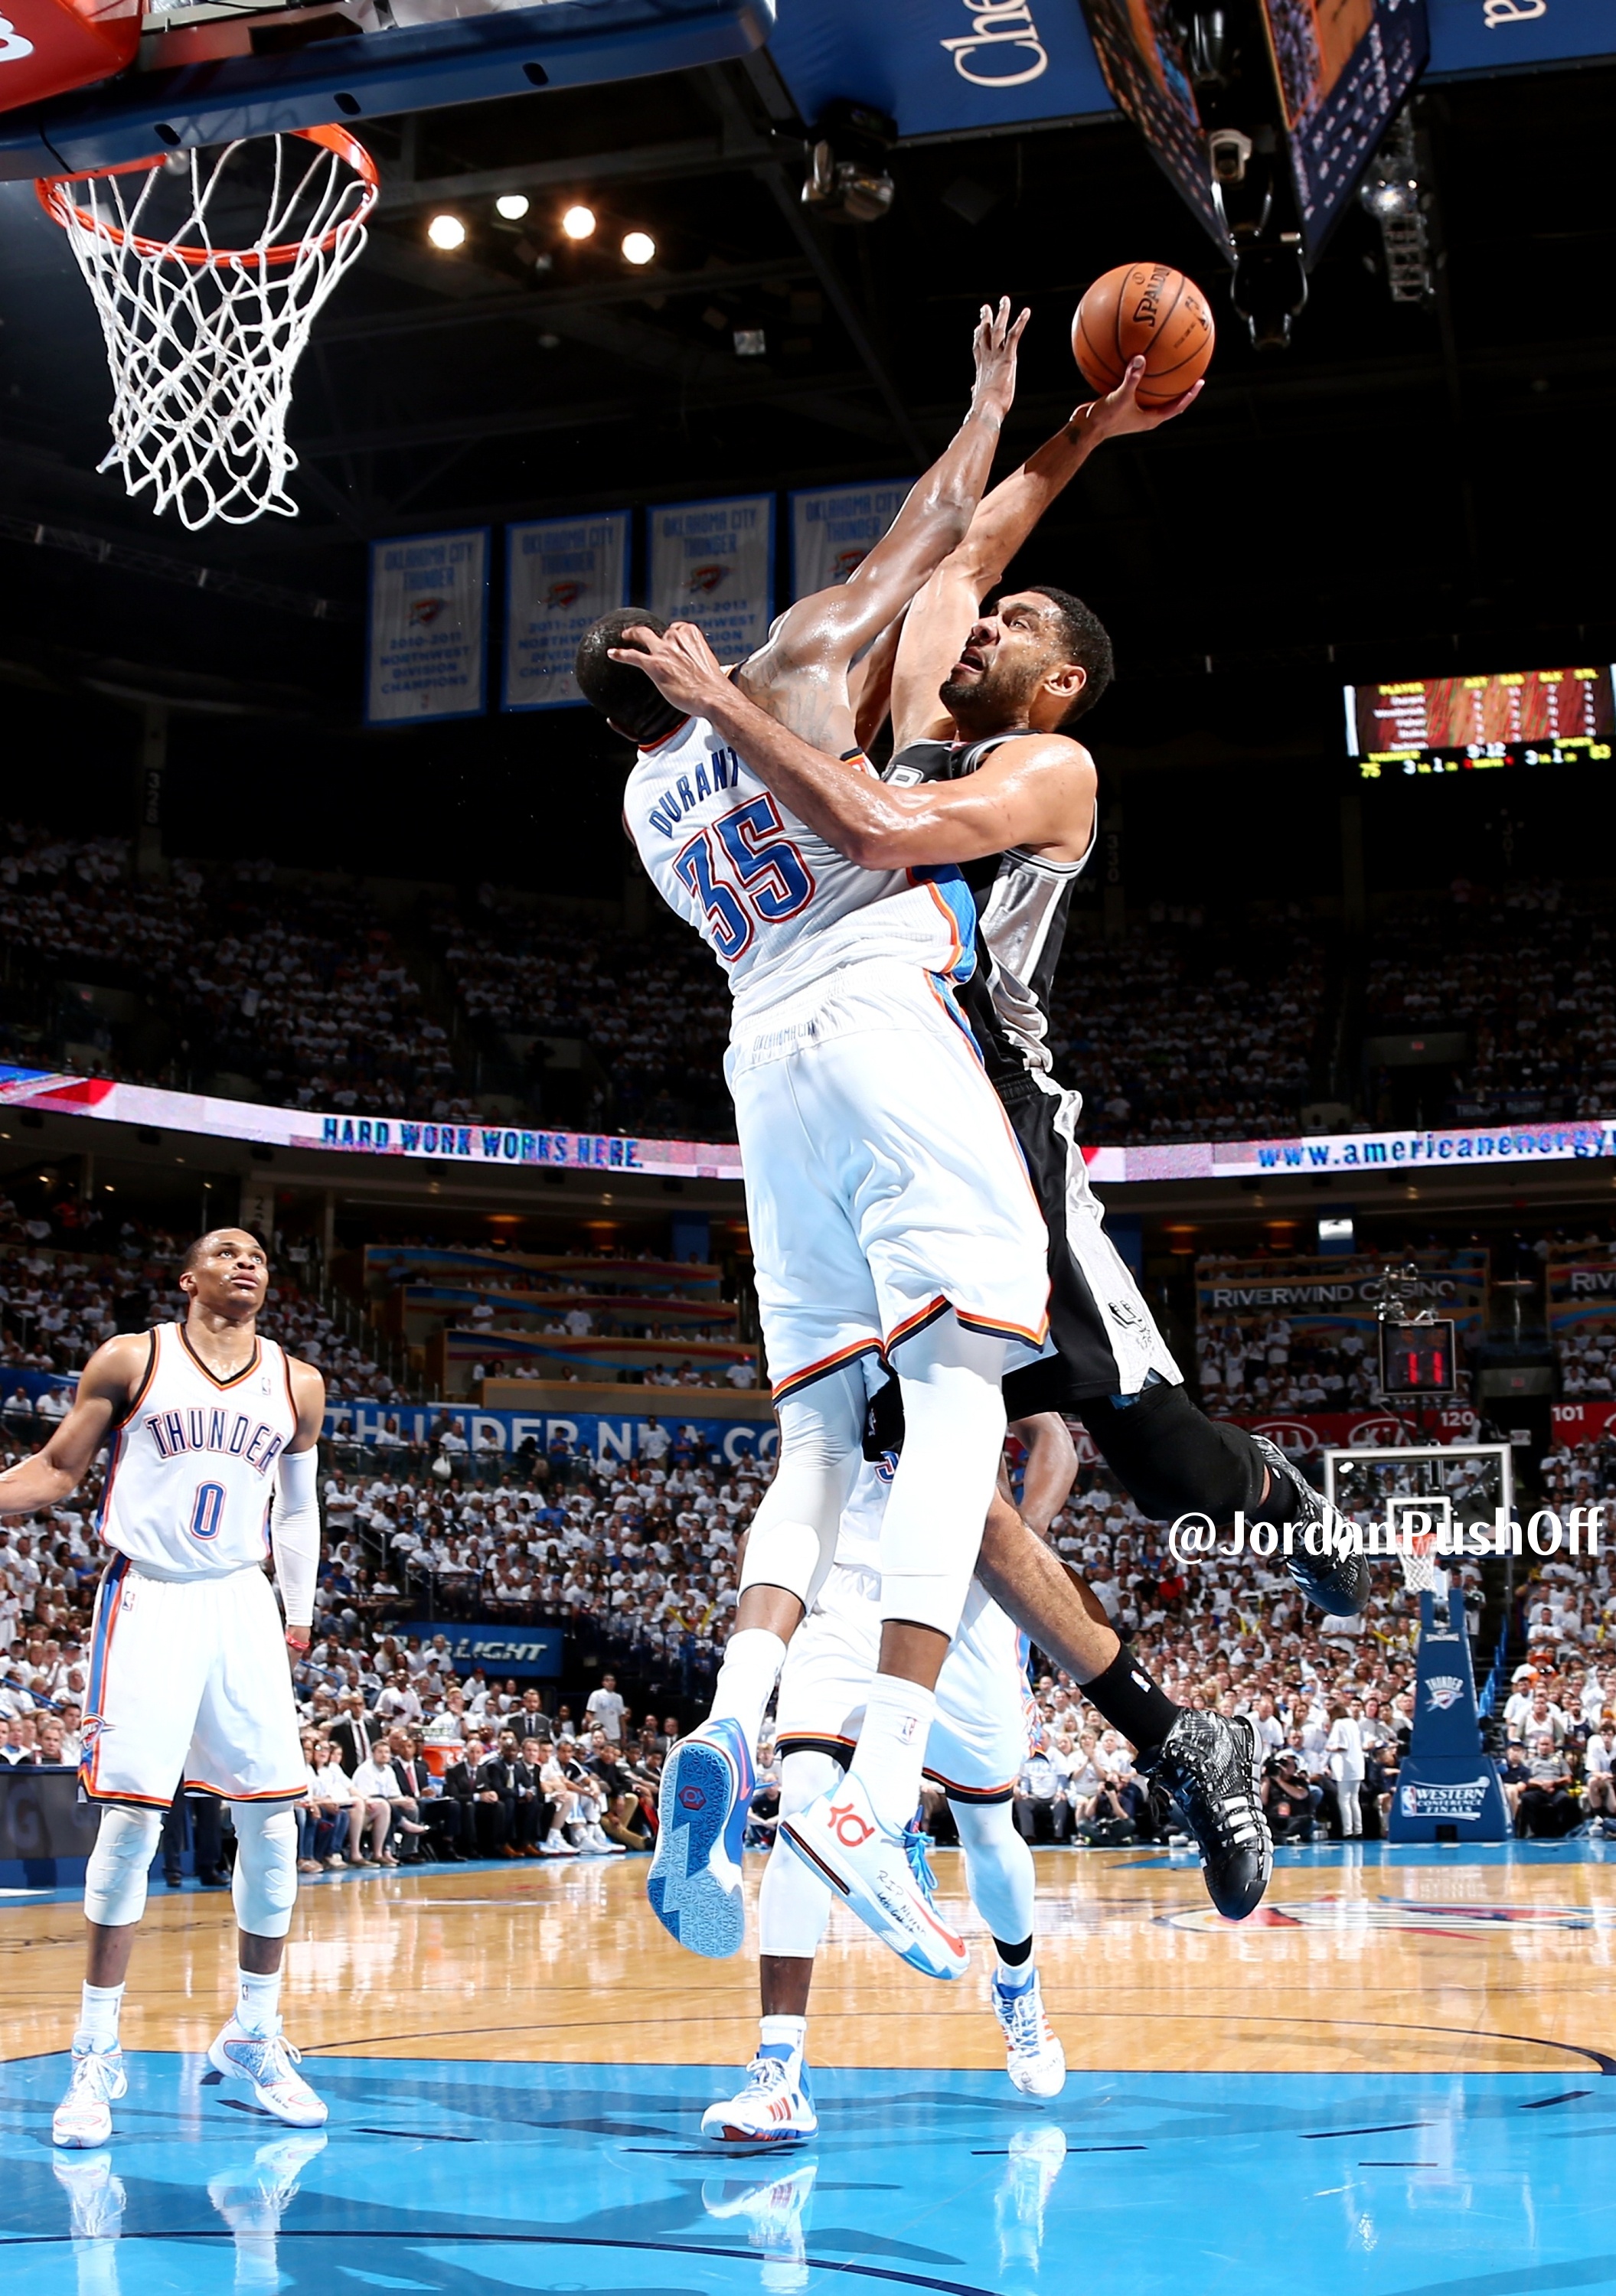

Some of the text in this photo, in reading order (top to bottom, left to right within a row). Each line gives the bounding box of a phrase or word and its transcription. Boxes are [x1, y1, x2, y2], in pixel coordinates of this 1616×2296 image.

[663, 508, 756, 537] OKLAHOMA CITY
[684, 533, 736, 558] THUNDER
[529, 615, 599, 633] 2011-201
[697, 615, 755, 629] THWEST
[518, 634, 582, 650] NORTHW
[380, 646, 470, 666] NORTHWEST
[531, 649, 576, 664] DIVISI
[393, 662, 457, 678] DIVISION
[519, 664, 573, 678] CHAMP
[381, 673, 468, 693] CHAMPIONS
[648, 746, 739, 839] DURANT
[672, 791, 815, 963] 35
[323, 1117, 390, 1147] HARD
[400, 1123, 472, 1156] WORK
[482, 1130, 568, 1162] WORKS
[1258, 1129, 1616, 1167] www.americanenergy
[1572, 1272, 1616, 1292] RIV
[1213, 1284, 1355, 1308] RIVERWIND
[1440, 1411, 1476, 1427] 120
[1552, 1406, 1585, 1422] 101
[143, 1407, 286, 1477] THUNDER
[189, 1479, 227, 1541] 0
[453, 1637, 549, 1662] LIGHT
[1424, 1676, 1464, 1691] THUNDER
[1416, 1788, 1486, 1800] WESTERN
